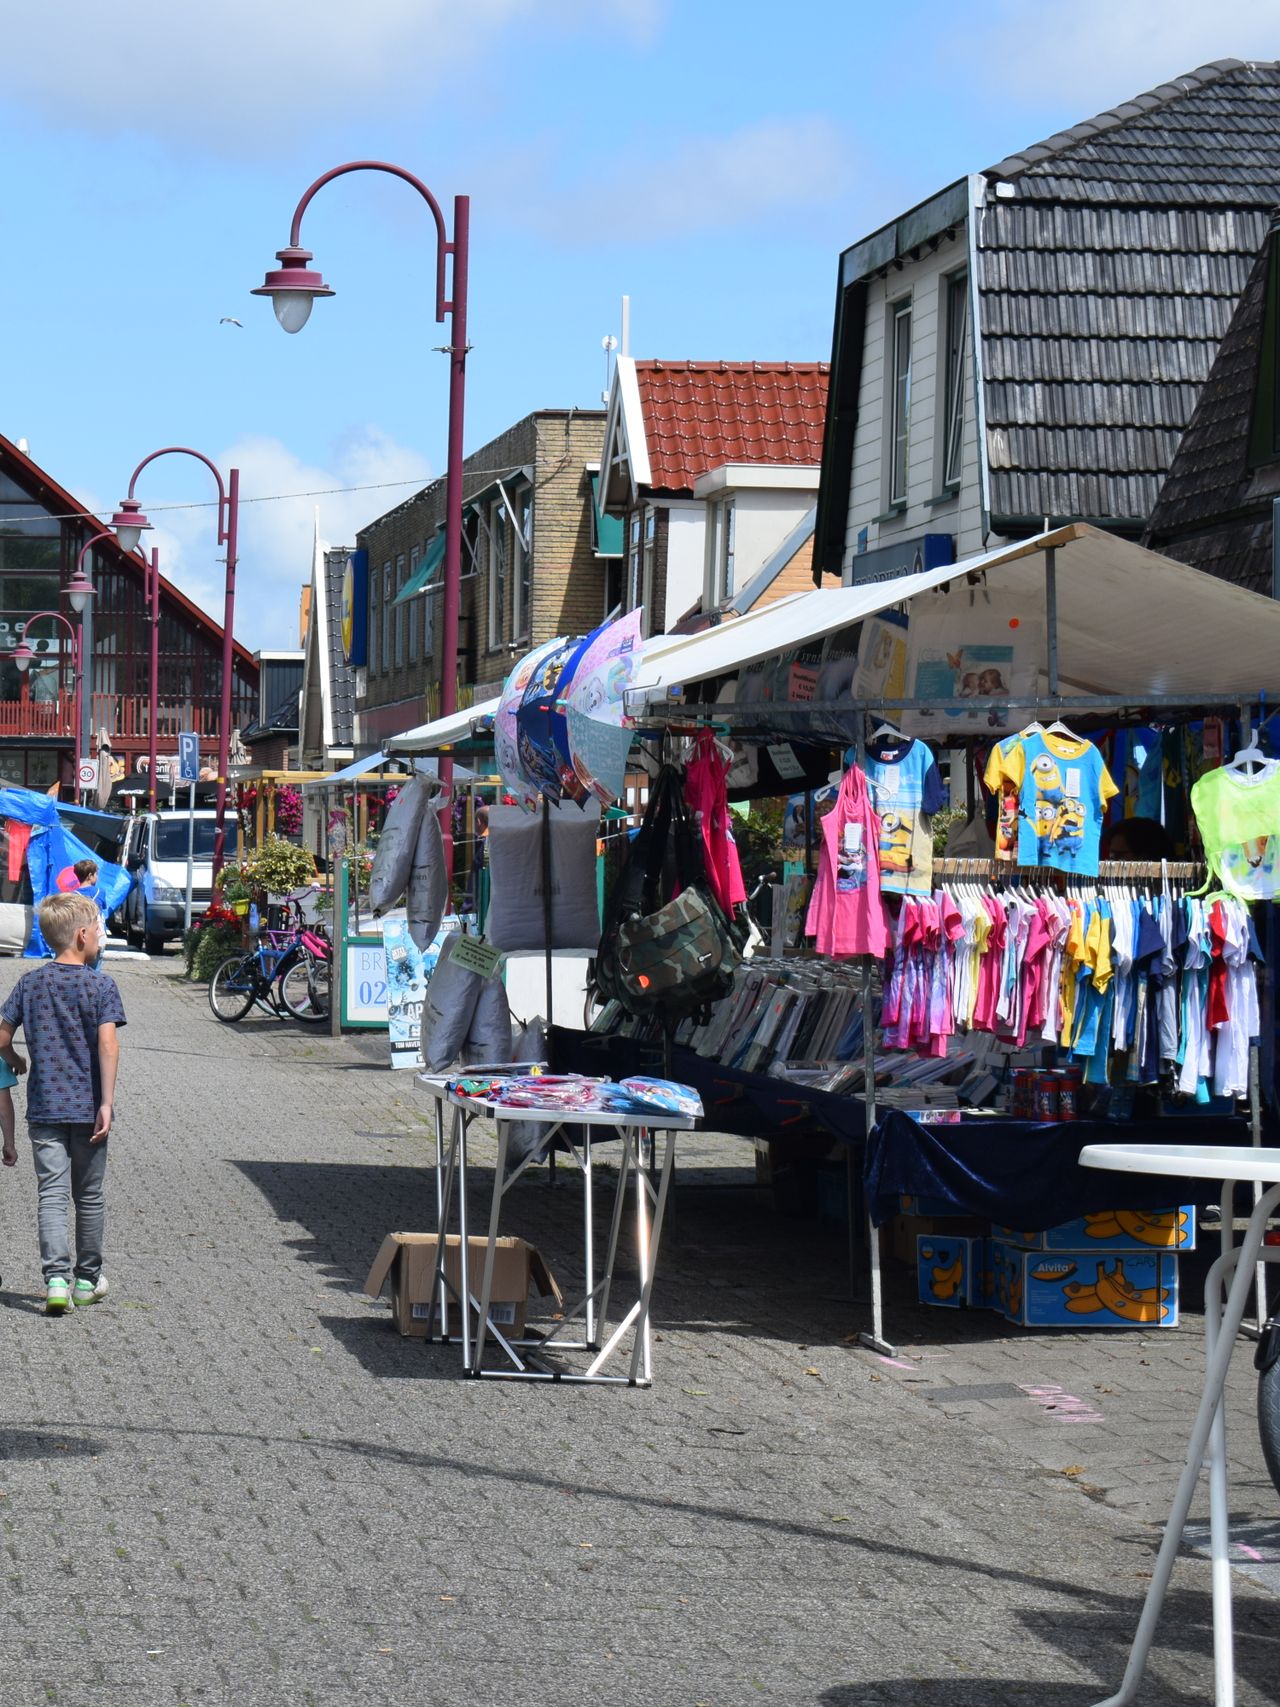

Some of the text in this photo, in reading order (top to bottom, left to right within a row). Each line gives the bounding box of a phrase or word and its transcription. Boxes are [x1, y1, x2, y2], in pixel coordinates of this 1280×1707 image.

[183, 737, 193, 760] P
[81, 770, 92, 778] 30
[359, 981, 387, 1005] 02
[1038, 1263, 1069, 1272] Alvita
